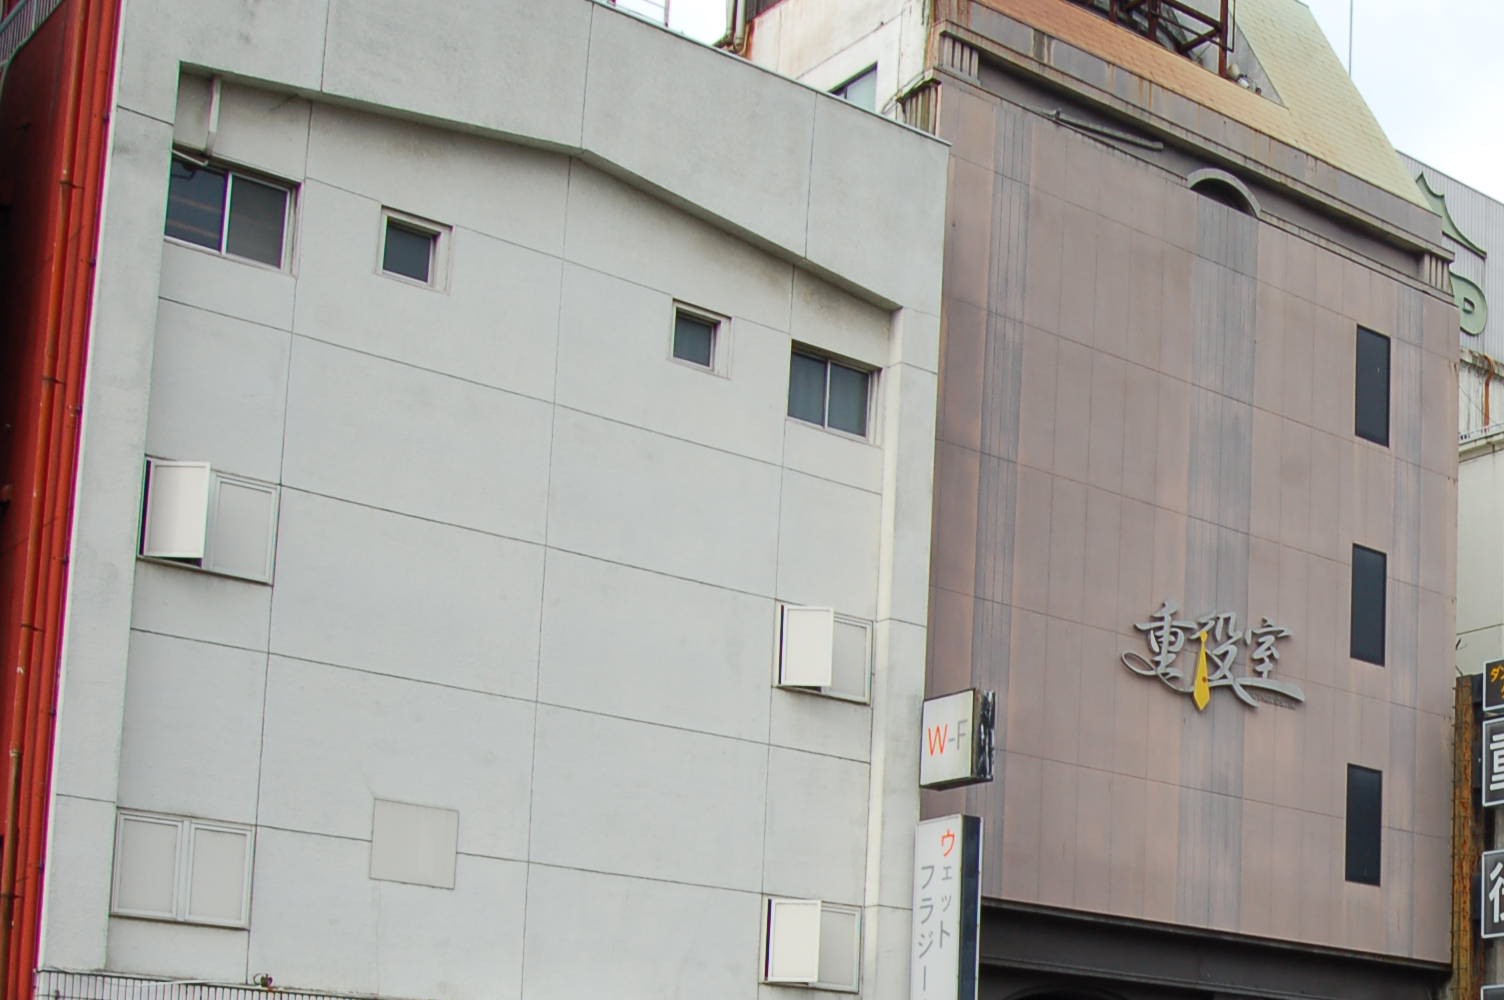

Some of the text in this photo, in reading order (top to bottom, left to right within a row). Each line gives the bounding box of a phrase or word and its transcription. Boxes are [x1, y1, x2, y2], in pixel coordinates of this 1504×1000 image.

[1121, 601, 1306, 711] 重役室
[927, 718, 968, 757] W-F
[938, 828, 955, 950] ウェット
